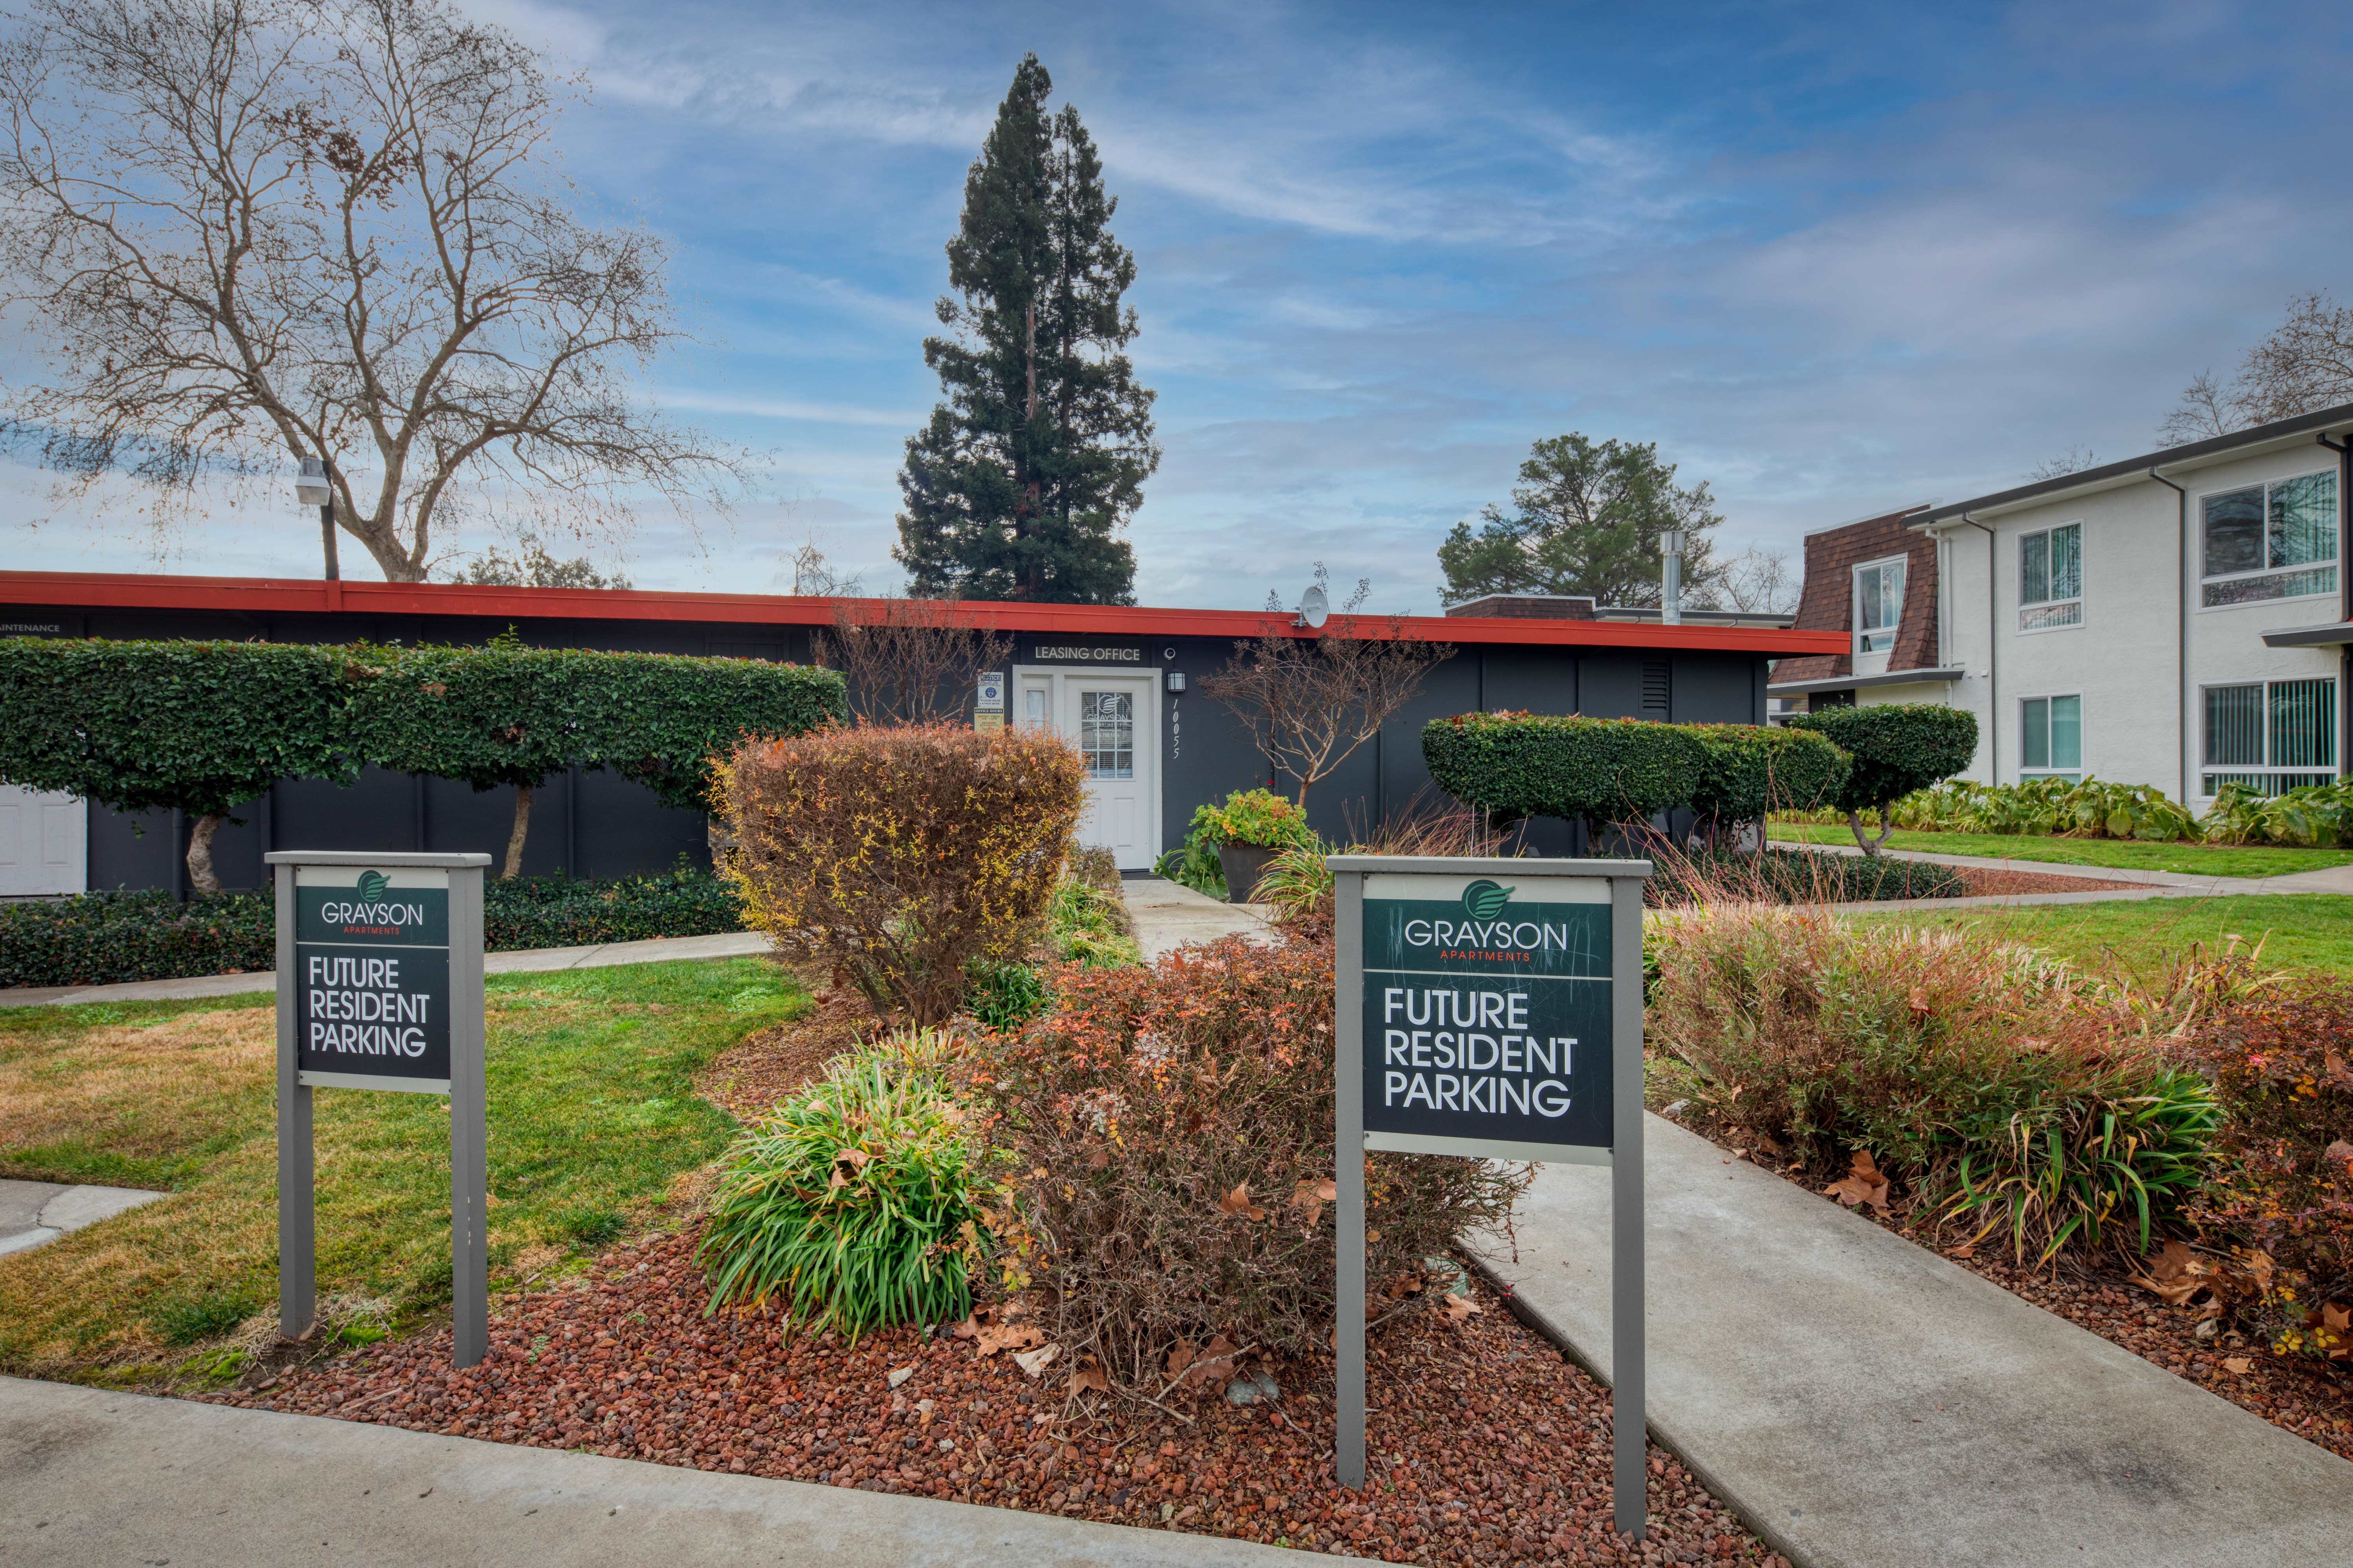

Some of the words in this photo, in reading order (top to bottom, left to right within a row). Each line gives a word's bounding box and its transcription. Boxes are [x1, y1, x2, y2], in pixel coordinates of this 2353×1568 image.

[1035, 647, 1089, 659] LEASING
[1094, 648, 1140, 660] OFFICE
[322, 902, 423, 925] GRAYSON
[344, 926, 400, 935] APARTMENTS
[1404, 919, 1567, 950] GRAYSON
[309, 956, 398, 988] FUTURE
[1440, 950, 1530, 962] APARTMENTS
[310, 989, 430, 1023] RESIDENT
[1385, 988, 1528, 1030] FUTURE
[311, 1023, 426, 1057] PARKING
[1385, 1029, 1578, 1075] RESIDENT
[1386, 1071, 1571, 1118] PARKING
